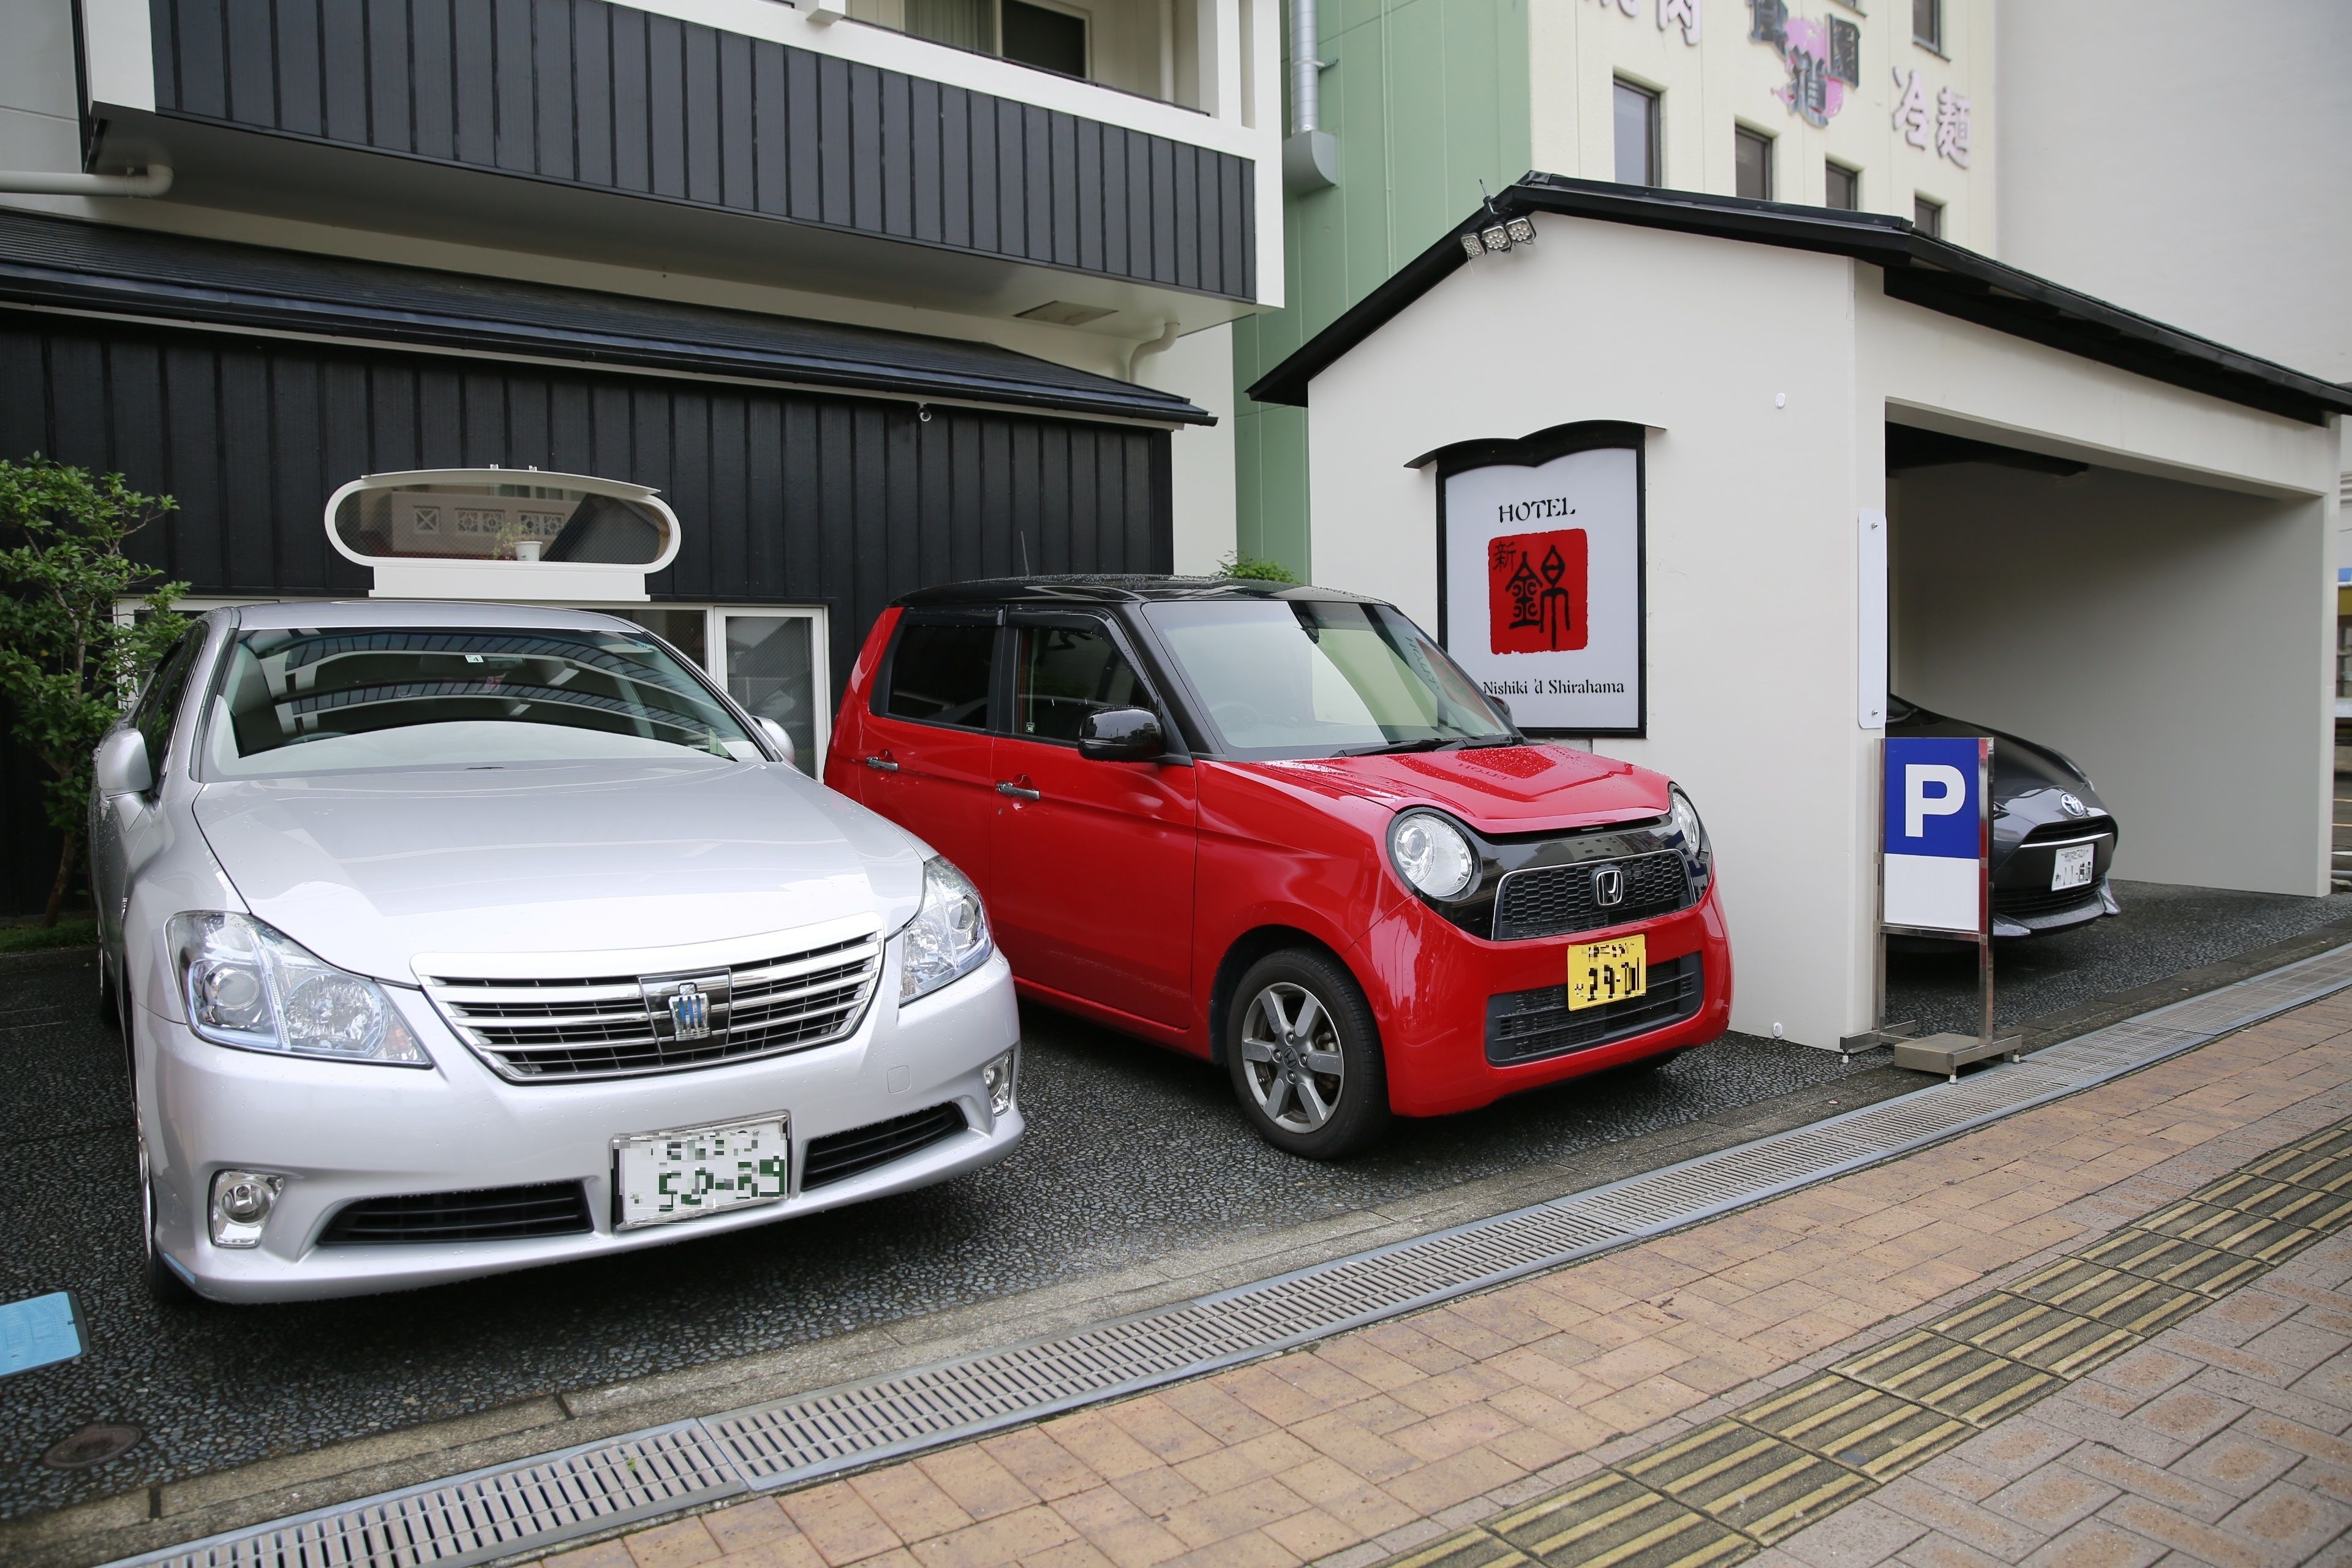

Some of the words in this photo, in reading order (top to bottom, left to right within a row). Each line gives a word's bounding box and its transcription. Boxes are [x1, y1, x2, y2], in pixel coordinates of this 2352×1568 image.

[1499, 497, 1575, 522] HOTEL
[1483, 680, 1528, 695] Nishiki
[1548, 679, 1624, 694] Shirahama
[1905, 764, 1966, 837] P
